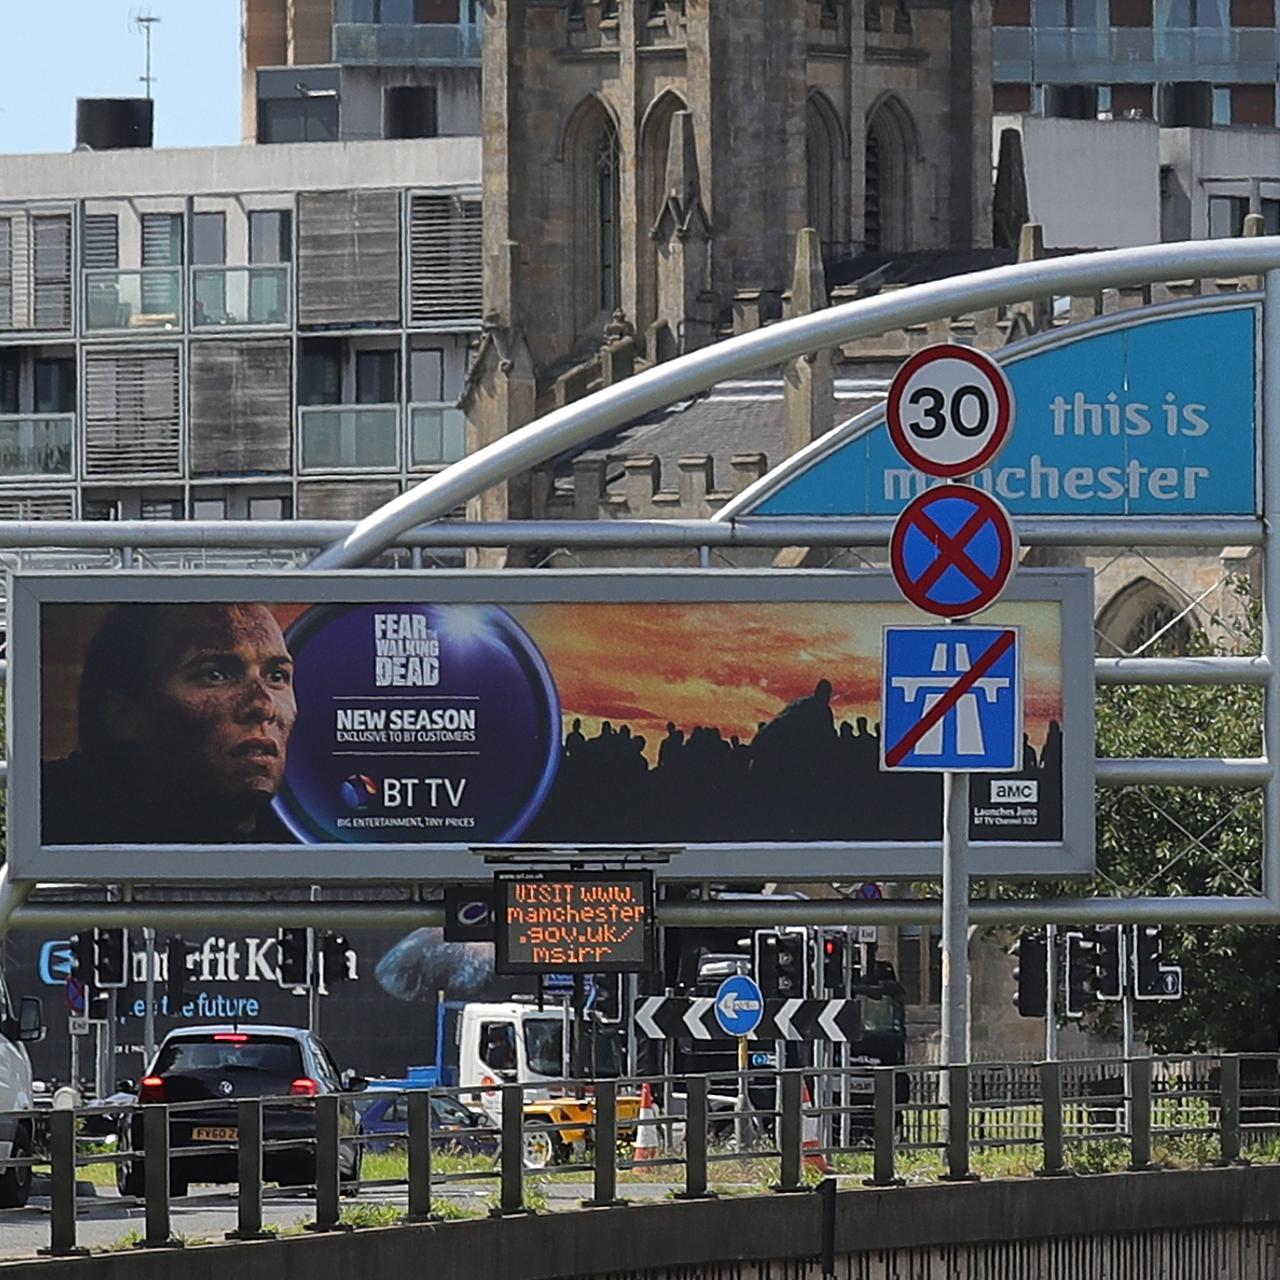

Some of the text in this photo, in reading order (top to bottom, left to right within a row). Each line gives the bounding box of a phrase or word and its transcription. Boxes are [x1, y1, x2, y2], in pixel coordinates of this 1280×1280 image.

[909, 385, 990, 440] 30
[1049, 392, 1209, 436] this is
[884, 454, 1209, 500] mnchester
[374, 614, 427, 639] FEAR
[376, 640, 438, 656] WALKING
[376, 657, 439, 687] DEAD
[337, 709, 475, 730] NEW SEASON
[337, 731, 475, 742] EXCLUSIVE TO BT CUSTOMERS
[384, 778, 467, 807] BT TV
[974, 807, 1014, 816] Launches
[337, 818, 351, 827] BIG
[425, 818, 444, 827] TINY
[445, 818, 475, 827] PRICES
[515, 884, 636, 903] VISIT www.
[507, 904, 646, 923] manchester
[520, 923, 634, 944] .gov.uk/
[533, 945, 613, 964] msirr
[198, 992, 260, 1017] future
